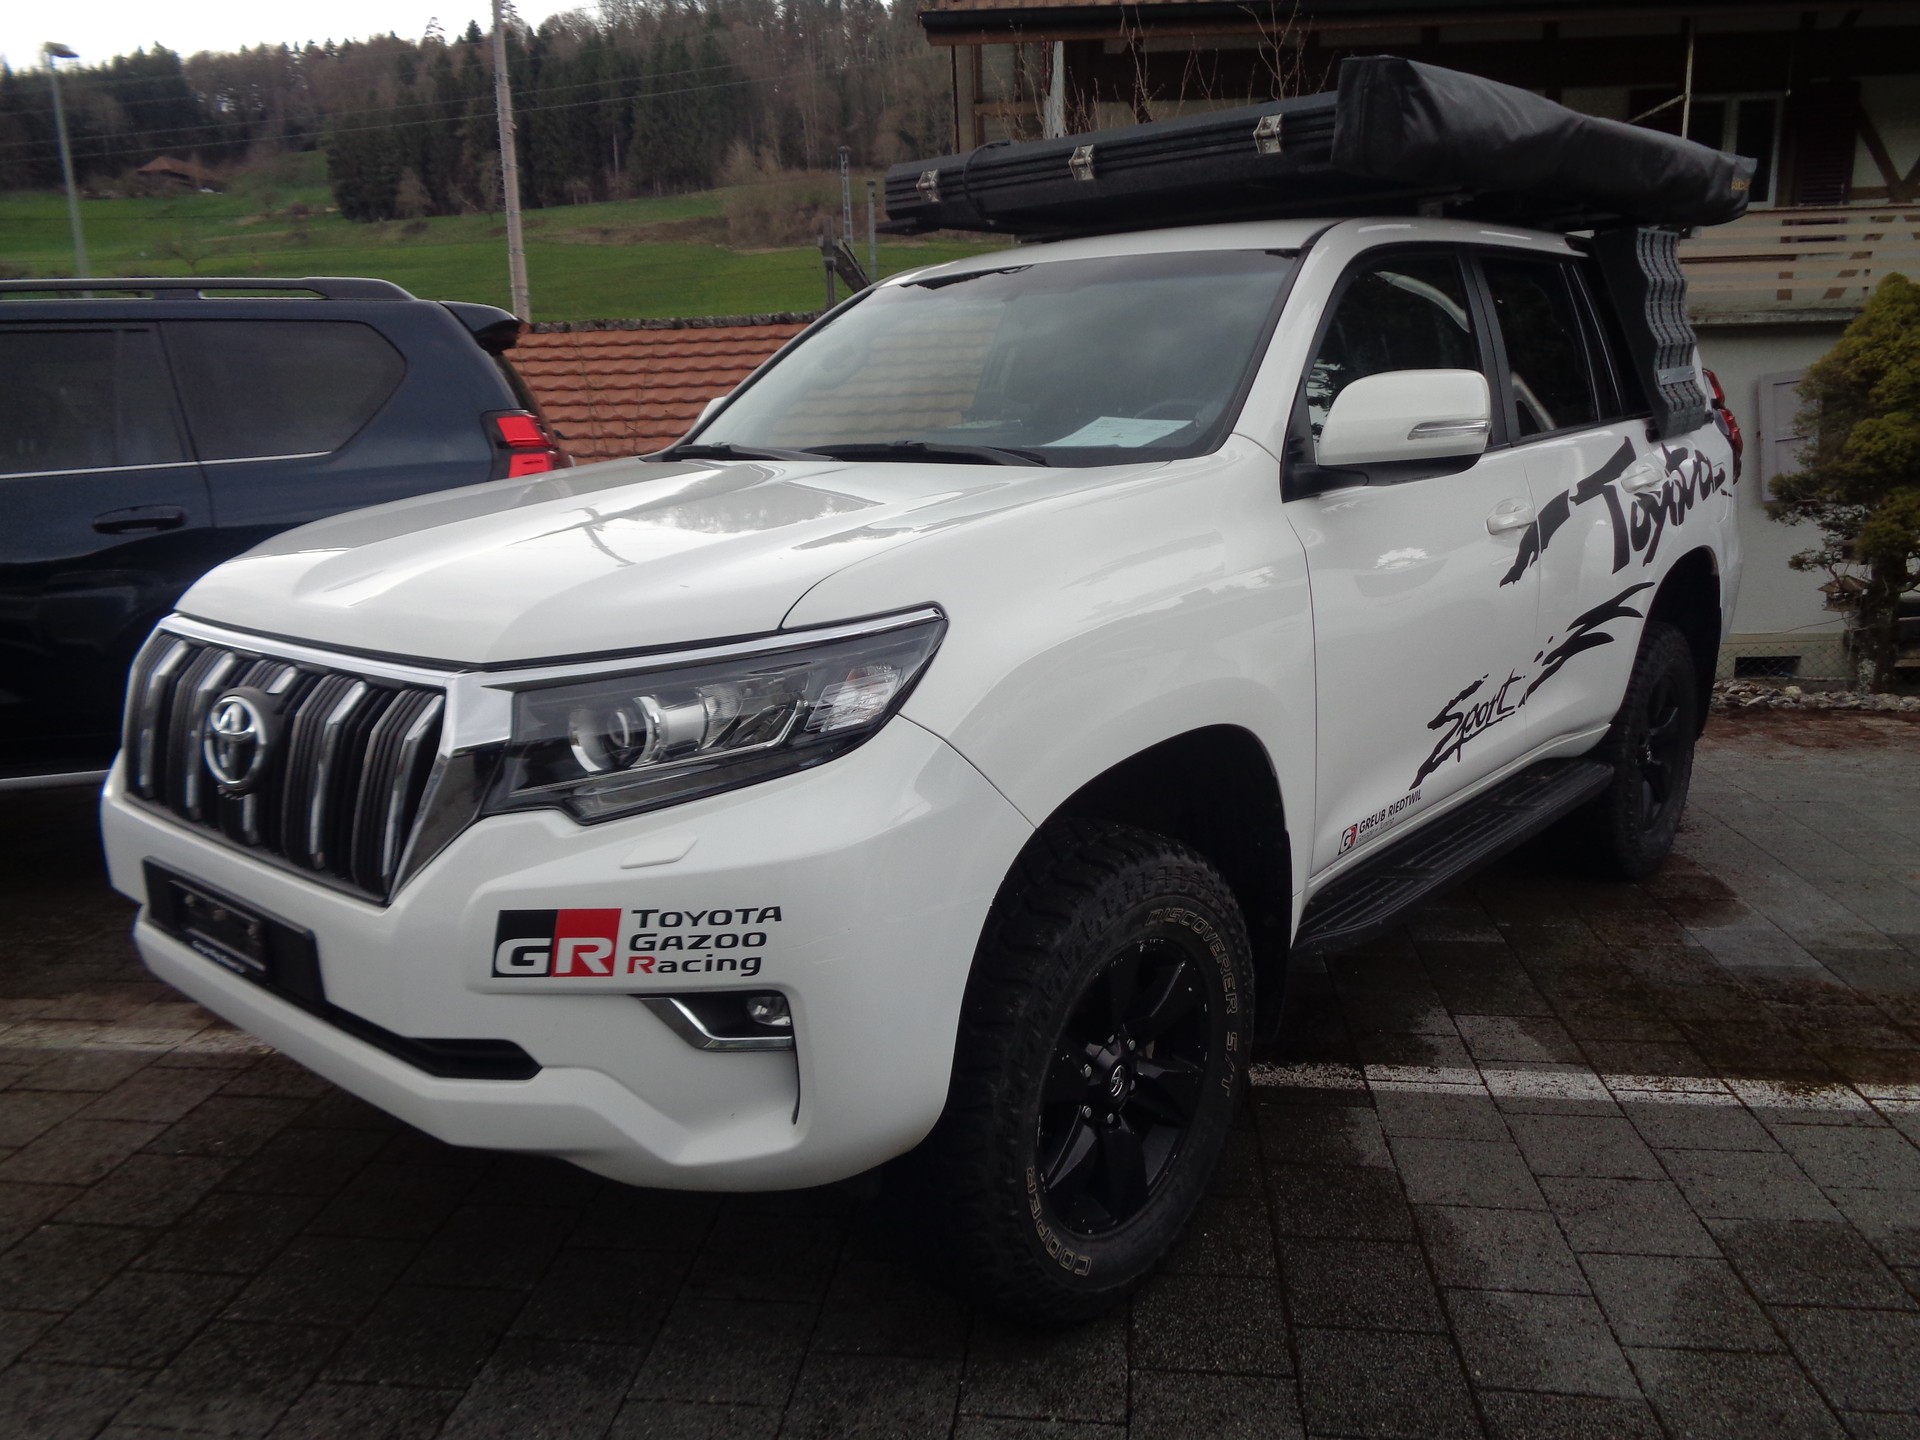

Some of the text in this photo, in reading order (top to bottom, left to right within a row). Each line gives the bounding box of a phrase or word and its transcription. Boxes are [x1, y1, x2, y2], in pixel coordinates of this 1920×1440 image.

[1359, 808, 1386, 834] GREUB
[1388, 789, 1422, 818] RIEDTWIL
[631, 906, 782, 929] TOYOTA
[494, 936, 615, 976] GR
[628, 931, 768, 952] GAZOO
[1144, 907, 1239, 1015] DISCOVERER
[626, 953, 762, 977] Racing
[1026, 1166, 1092, 1276] COOPER
